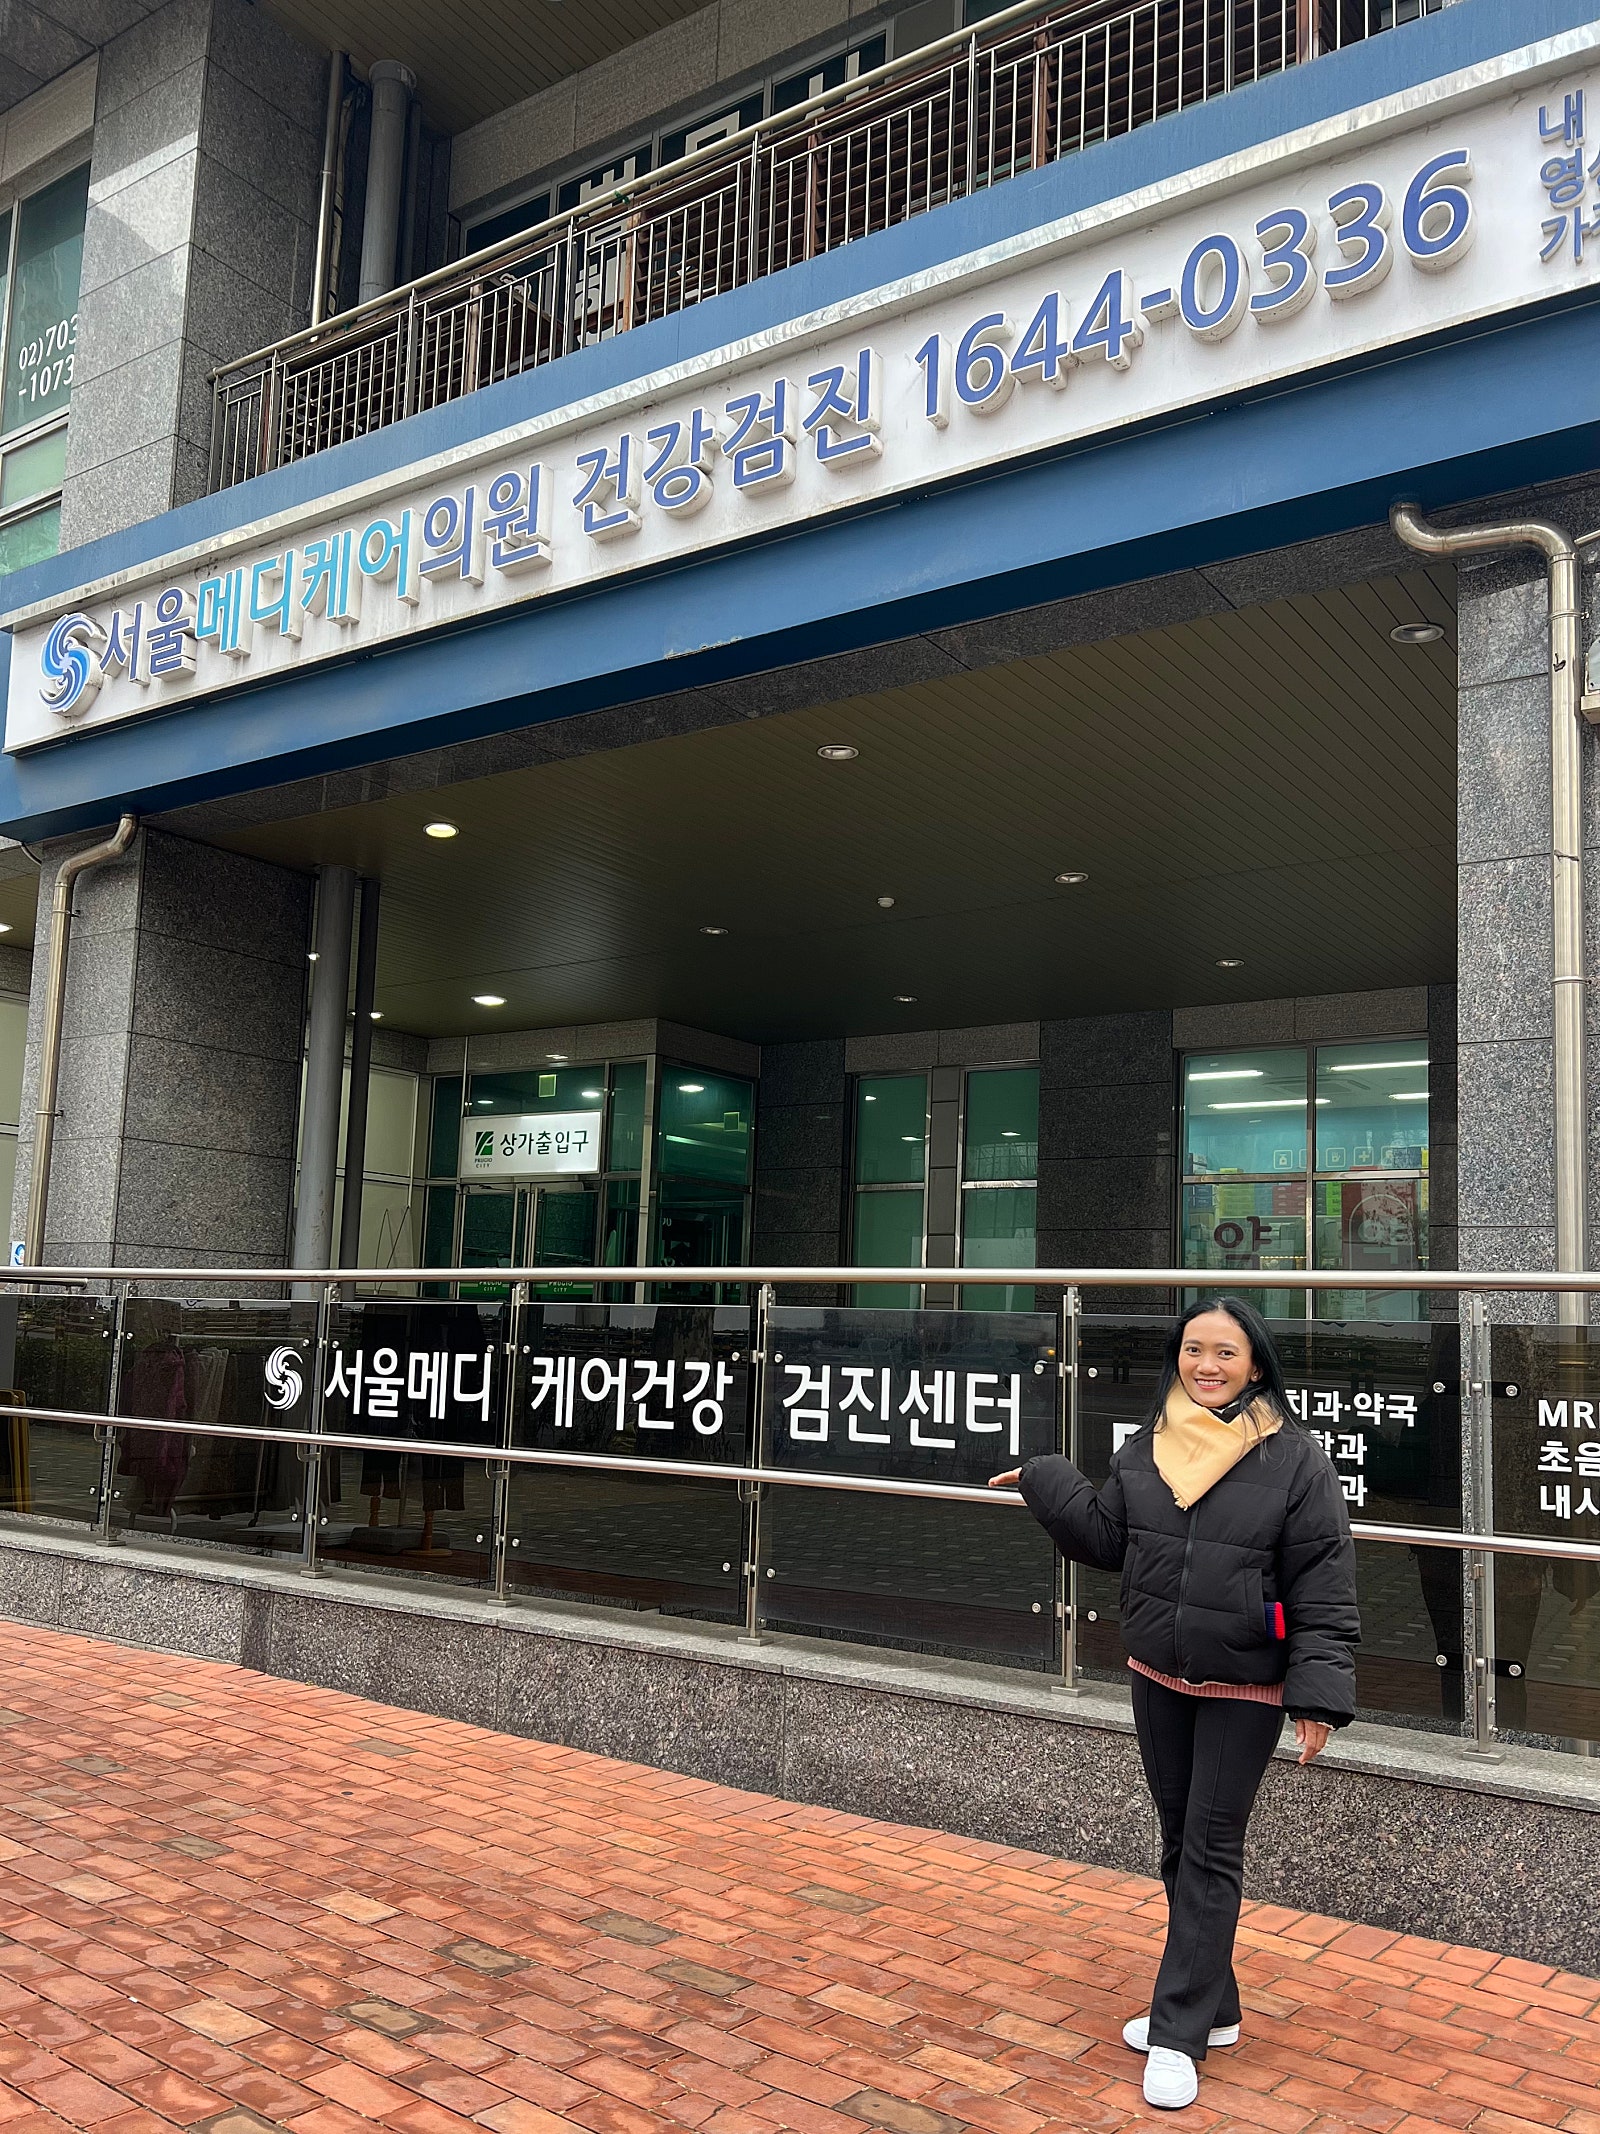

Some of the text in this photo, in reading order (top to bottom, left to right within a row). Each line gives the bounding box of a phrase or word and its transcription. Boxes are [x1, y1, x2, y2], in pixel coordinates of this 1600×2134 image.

[1539, 146, 1600, 205] 영
[571, 347, 876, 535] 건강검진
[914, 147, 1475, 420] 1644-0336
[18, 353, 75, 402] -1073
[500, 1130, 590, 1157] 상가출입구
[782, 1364, 1021, 1456] 검진센터
[1538, 1399, 1600, 1429] MR
